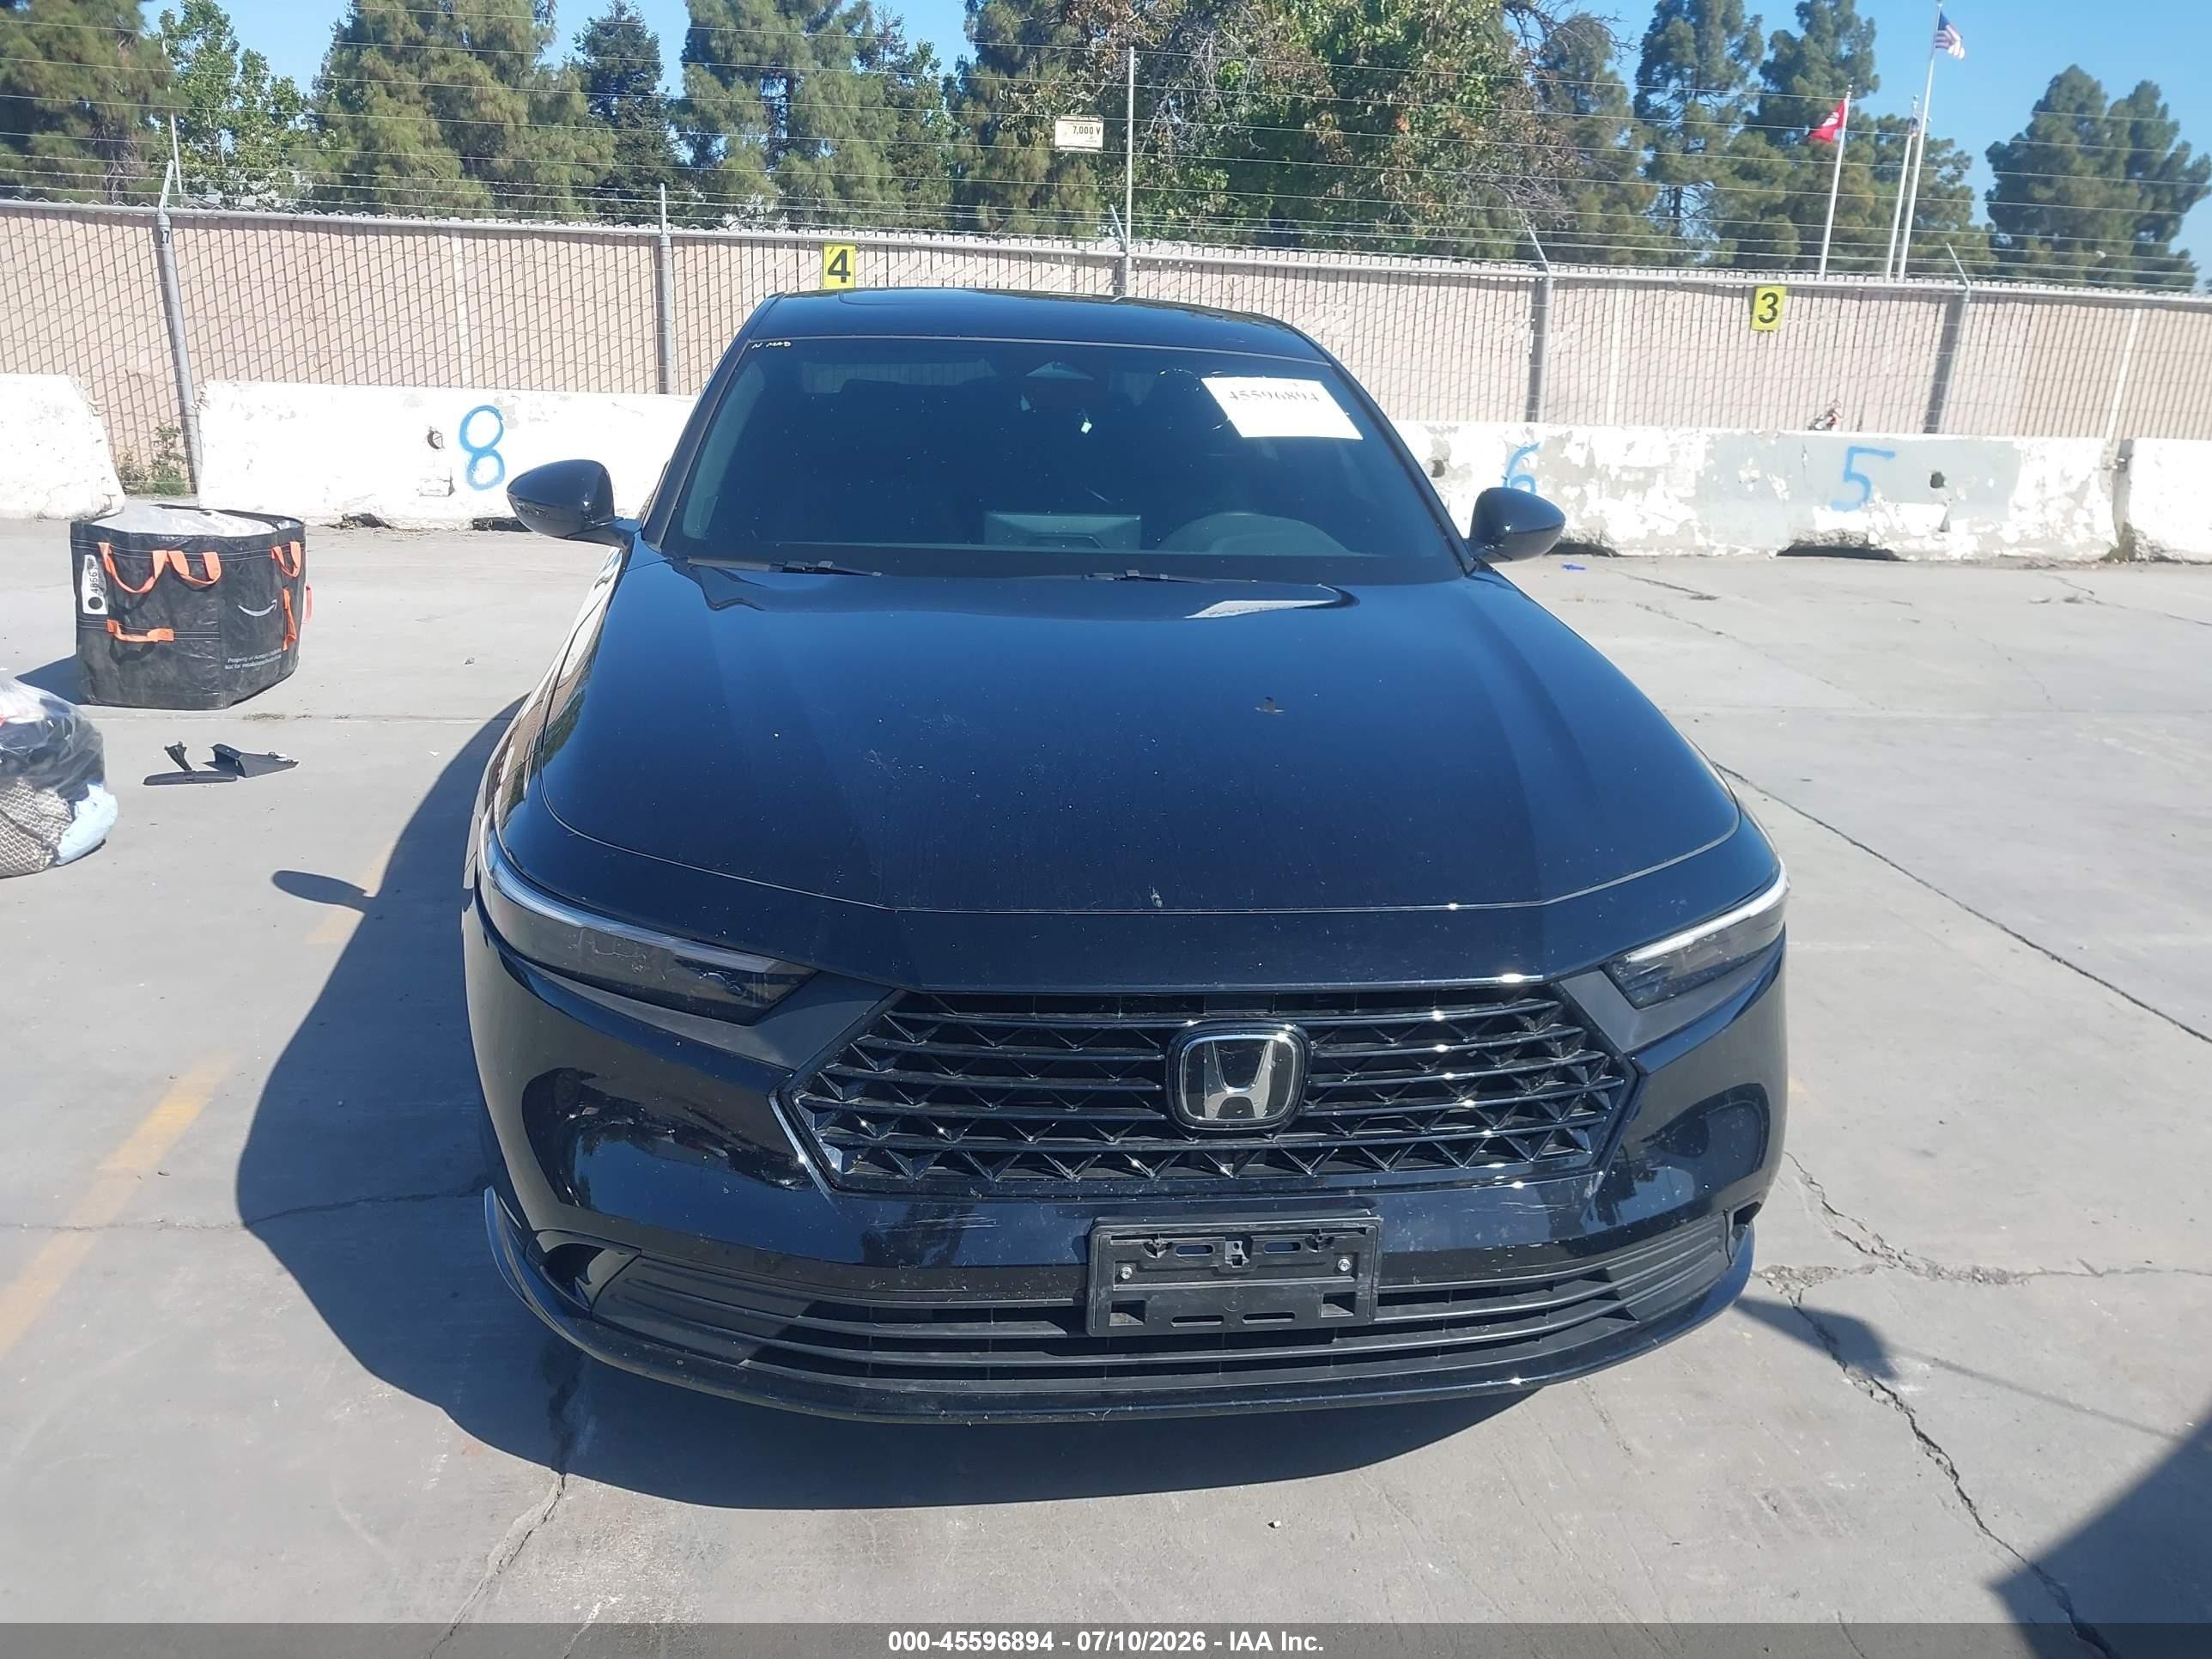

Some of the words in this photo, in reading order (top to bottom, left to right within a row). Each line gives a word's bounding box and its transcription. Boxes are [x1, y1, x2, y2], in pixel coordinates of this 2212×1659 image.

[1073, 125, 1094, 135] 7,000
[1096, 125, 1101, 135] V
[828, 249, 851, 283] 4
[1758, 292, 1778, 324] 3
[1229, 389, 1320, 404] 45596894
[459, 404, 505, 491] 8
[1830, 445, 1895, 513] 5
